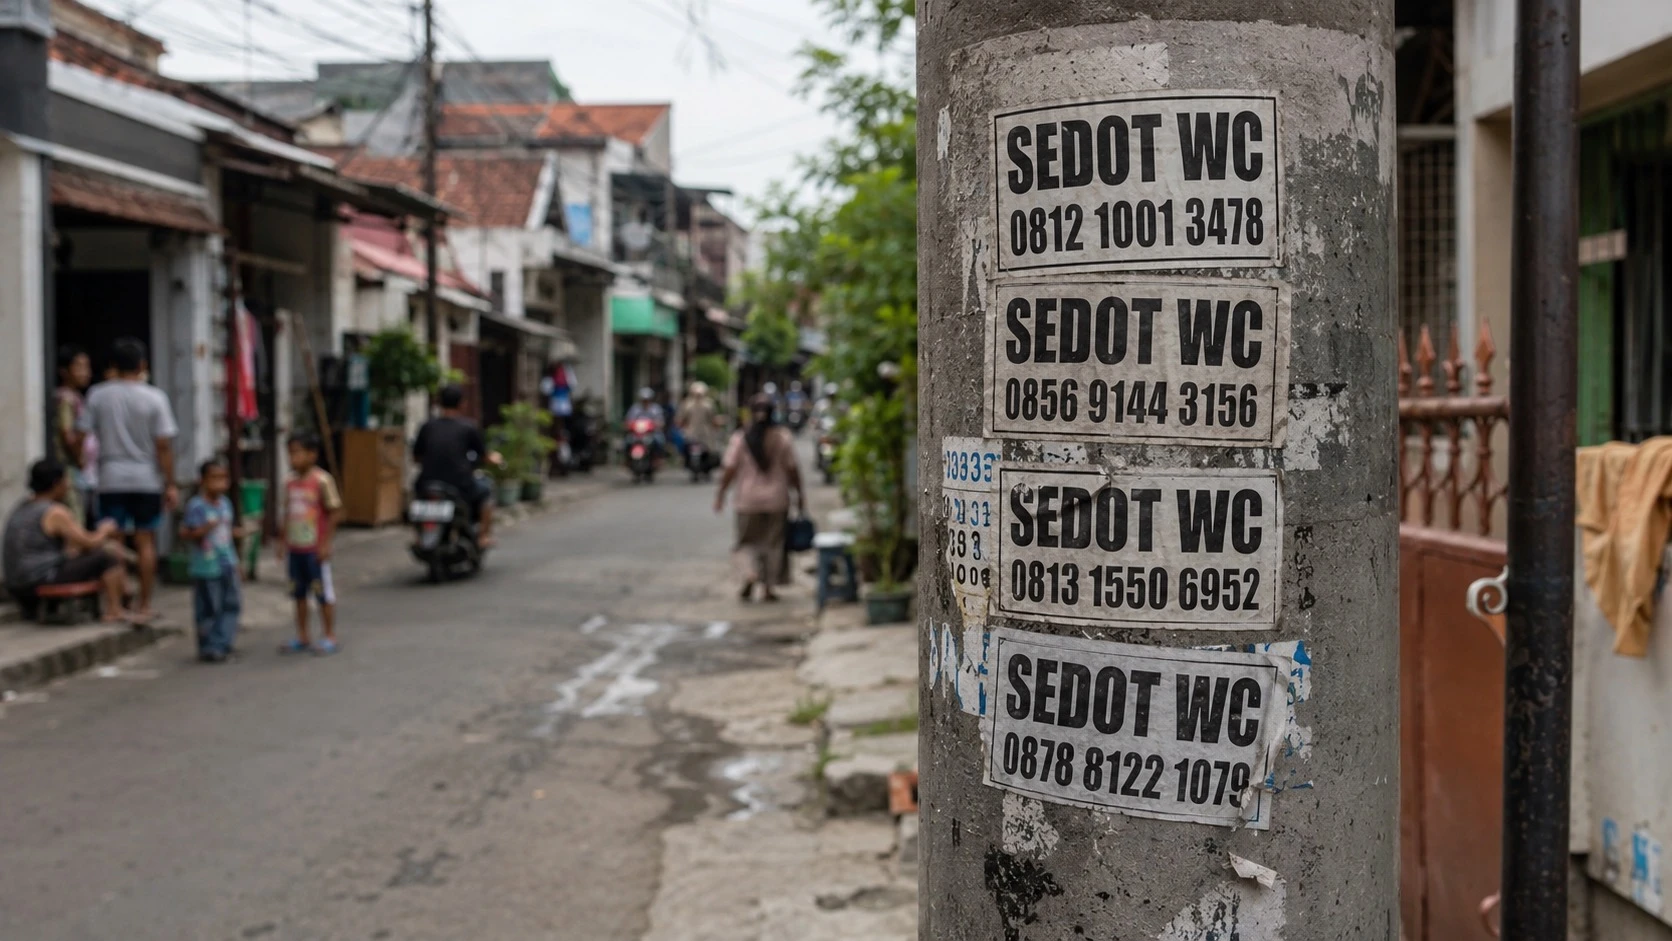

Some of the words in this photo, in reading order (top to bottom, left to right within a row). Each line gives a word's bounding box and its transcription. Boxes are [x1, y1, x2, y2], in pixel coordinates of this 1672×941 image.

[1006, 114, 1162, 195] SEDOT
[1176, 110, 1263, 182] WC
[1010, 204, 1084, 256] 0812
[1094, 199, 1174, 249] 1001
[1185, 197, 1264, 246] 3478
[1005, 296, 1162, 365] SEDOT
[1176, 298, 1263, 368] WC
[1005, 377, 1079, 421] 0856
[1088, 379, 1168, 424] 9144
[1178, 382, 1258, 428] 3156
[1010, 484, 1162, 553] SEDOT
[1176, 488, 1263, 554] WC
[1011, 559, 1080, 605] 0813
[1088, 564, 1168, 610] 1550
[1179, 567, 1260, 611] 6952
[1005, 653, 1162, 737] SEDOT
[1175, 673, 1262, 747] WC
[1003, 732, 1074, 787] 0878
[1082, 746, 1164, 800] 8122
[1174, 757, 1250, 808] 1079
